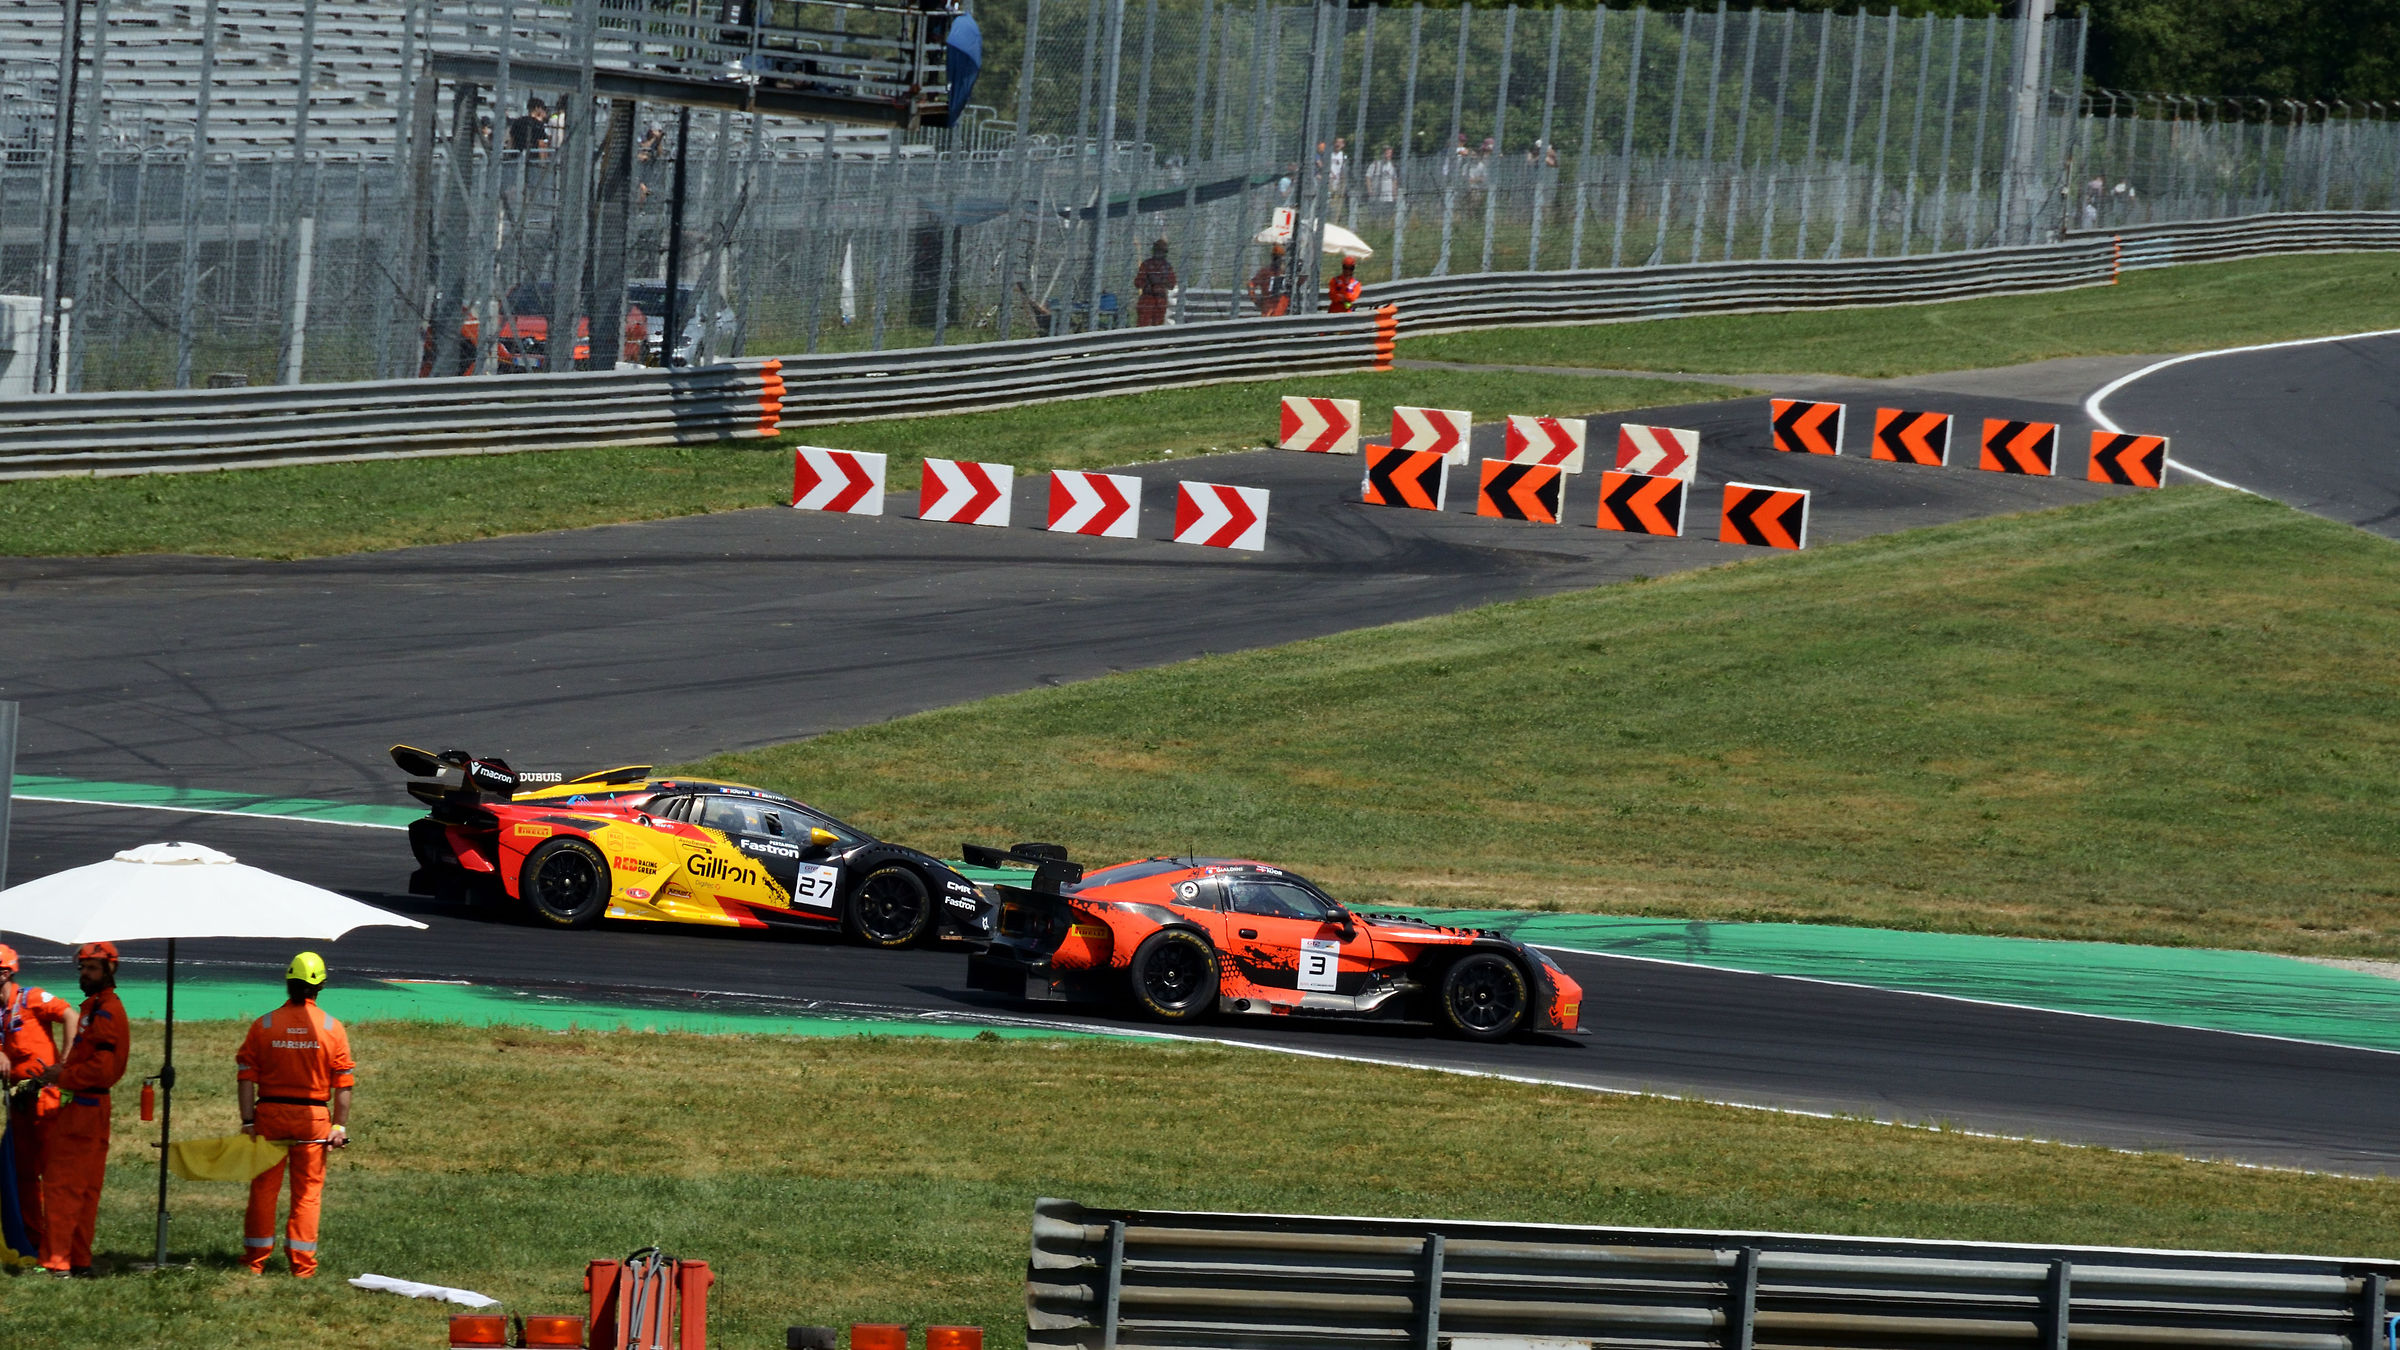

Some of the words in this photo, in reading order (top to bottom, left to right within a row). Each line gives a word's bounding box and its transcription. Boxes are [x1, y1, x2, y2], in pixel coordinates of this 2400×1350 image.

[480, 767, 512, 784] macron
[519, 772, 562, 783] DUBUIS
[740, 839, 799, 859] Fastron
[613, 855, 638, 872] RED
[637, 866, 657, 876] GREEN
[638, 859, 658, 869] RACING
[687, 853, 757, 886] Gillion
[798, 876, 833, 899] 27
[946, 881, 971, 895] CMR
[944, 895, 976, 912] Fastron
[1309, 955, 1326, 976] 3
[271, 1040, 320, 1049] MARSHAL
